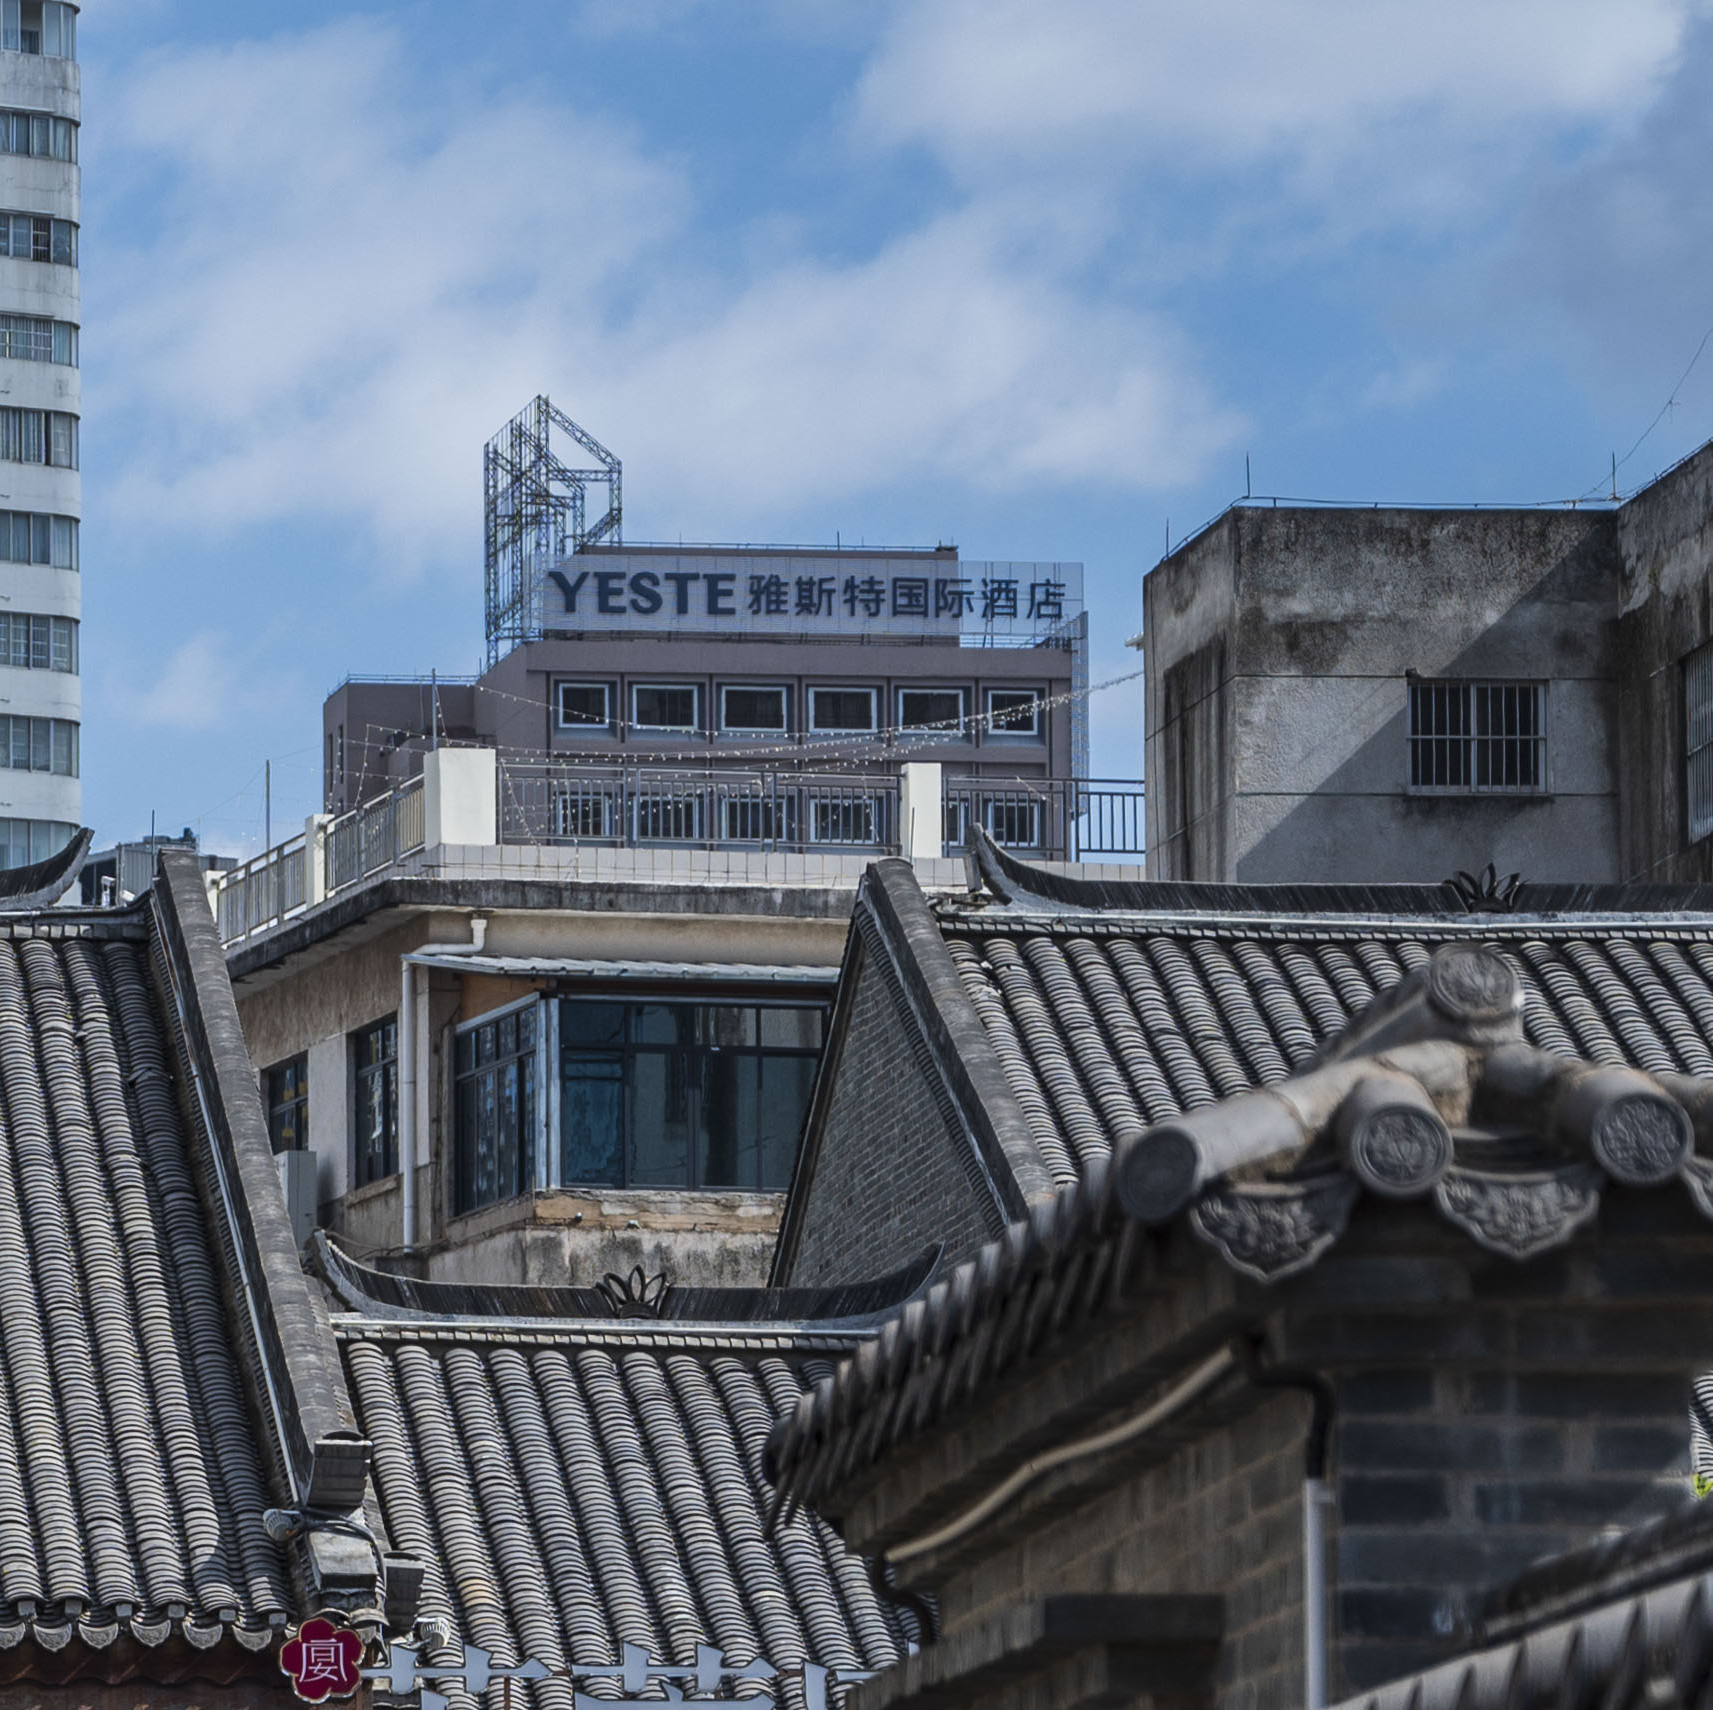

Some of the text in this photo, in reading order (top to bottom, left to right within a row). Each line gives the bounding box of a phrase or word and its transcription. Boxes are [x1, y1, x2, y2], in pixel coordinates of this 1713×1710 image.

[548, 571, 1066, 620] YESTE 雅斯特国际酒店
